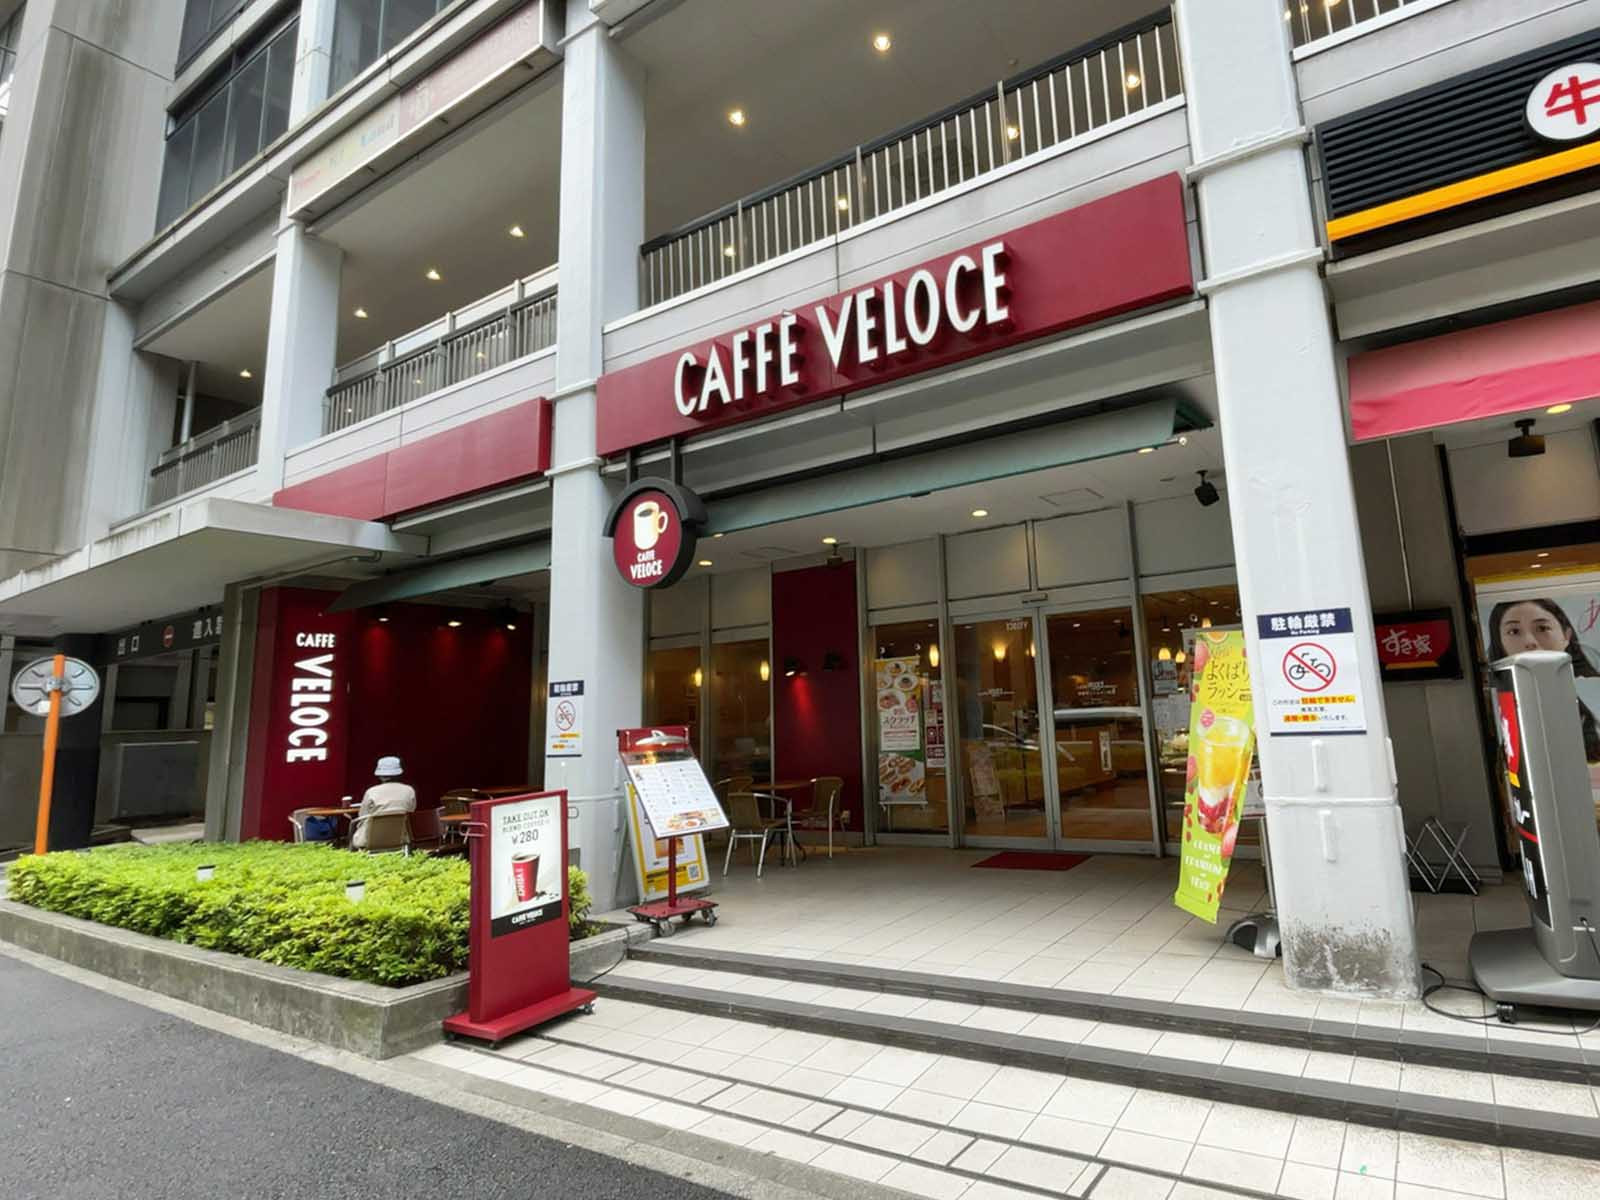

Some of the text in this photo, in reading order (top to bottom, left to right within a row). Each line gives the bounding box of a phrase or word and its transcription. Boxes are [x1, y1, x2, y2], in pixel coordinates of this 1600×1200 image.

[1544, 75, 1600, 125] 牛
[815, 242, 1009, 370] VELOCE
[630, 560, 663, 579] VELOCE
[1271, 612, 1336, 632] 駐輪厳禁
[296, 632, 336, 648] CAFFE
[1381, 628, 1433, 657] すき家
[286, 653, 335, 763] VELOCE
[503, 808, 549, 825] TAKE OUT OK
